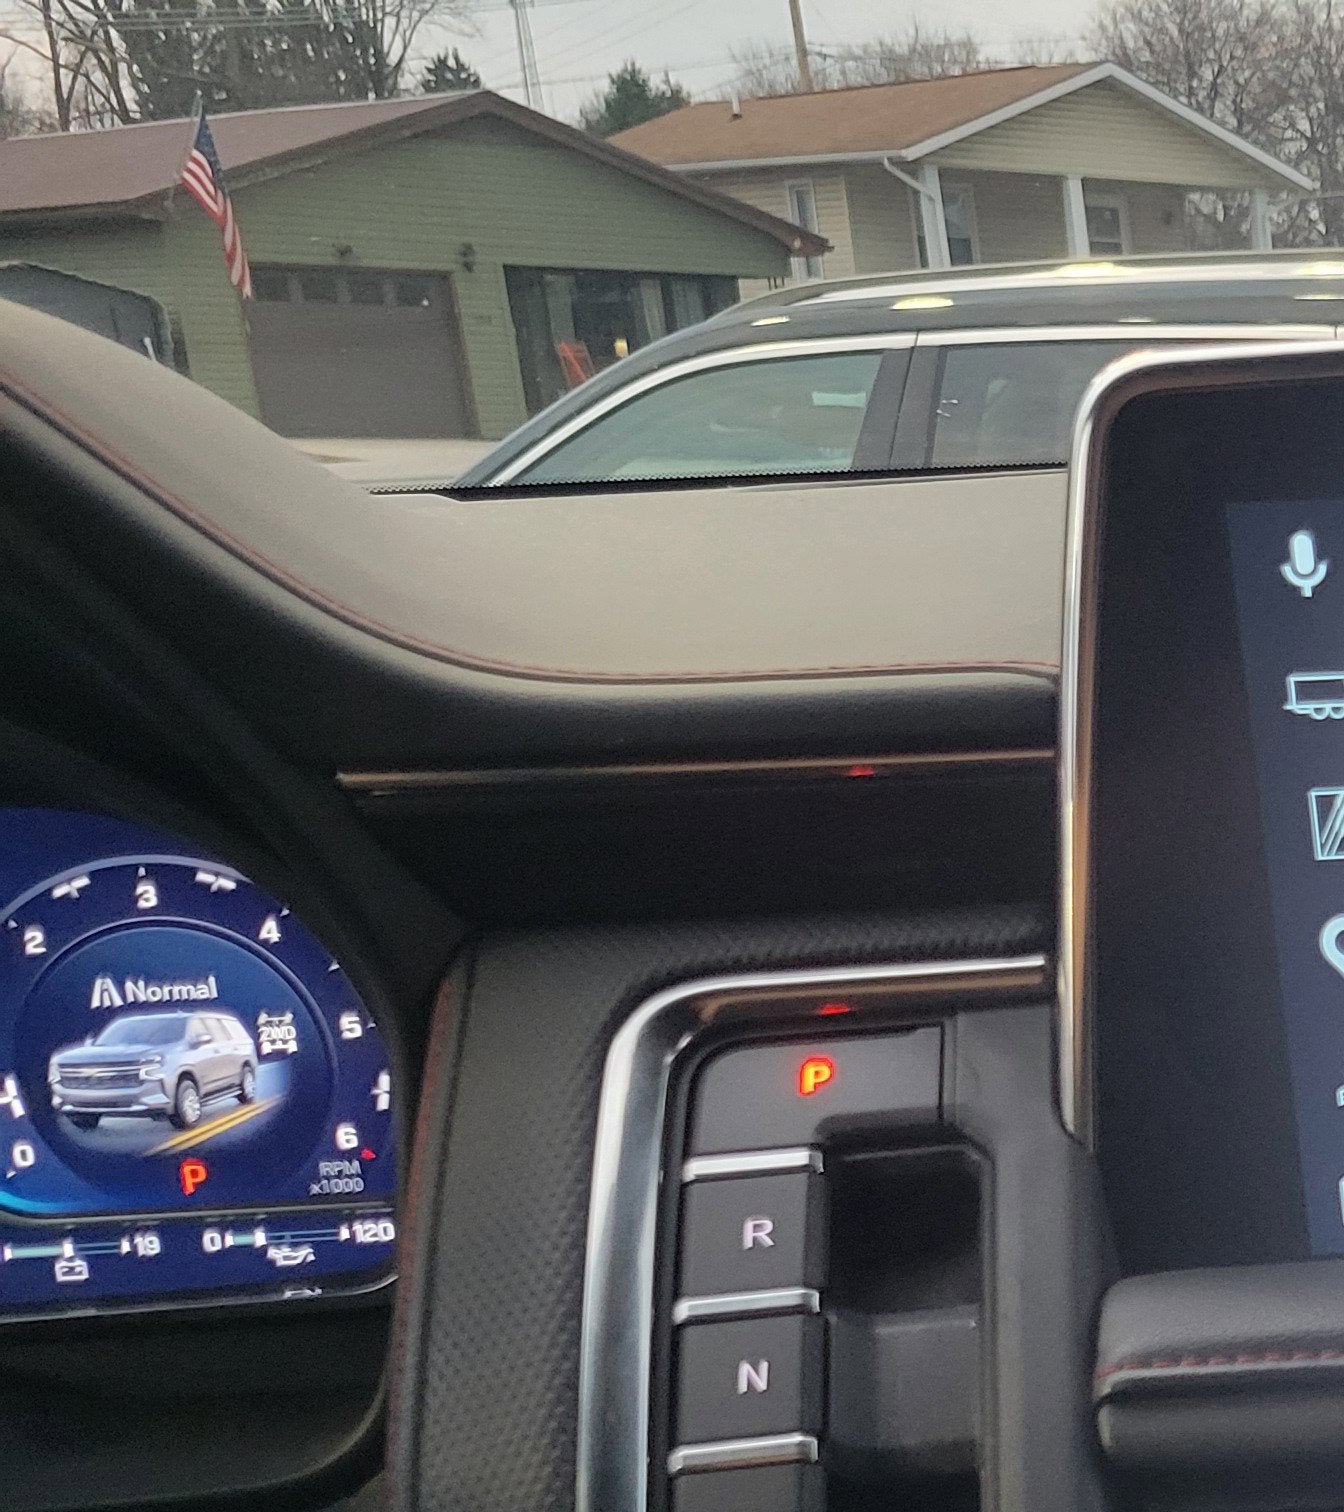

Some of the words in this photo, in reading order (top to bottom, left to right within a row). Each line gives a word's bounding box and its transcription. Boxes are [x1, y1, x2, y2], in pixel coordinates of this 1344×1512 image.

[136, 880, 158, 908] 3
[24, 925, 47, 955] 2
[258, 916, 281, 943] 4
[125, 976, 218, 1004] Normal
[340, 1012, 363, 1039] 5
[800, 1058, 834, 1096] P
[336, 1124, 359, 1149] 6
[12, 1143, 35, 1167] 0
[319, 1160, 362, 1177] RPM
[181, 1157, 208, 1196] P
[310, 1176, 365, 1196] x1000
[133, 1230, 161, 1258] 19
[202, 1228, 222, 1252] 0
[352, 1219, 395, 1246] 120
[742, 1218, 775, 1249] R
[737, 1360, 769, 1395] N
